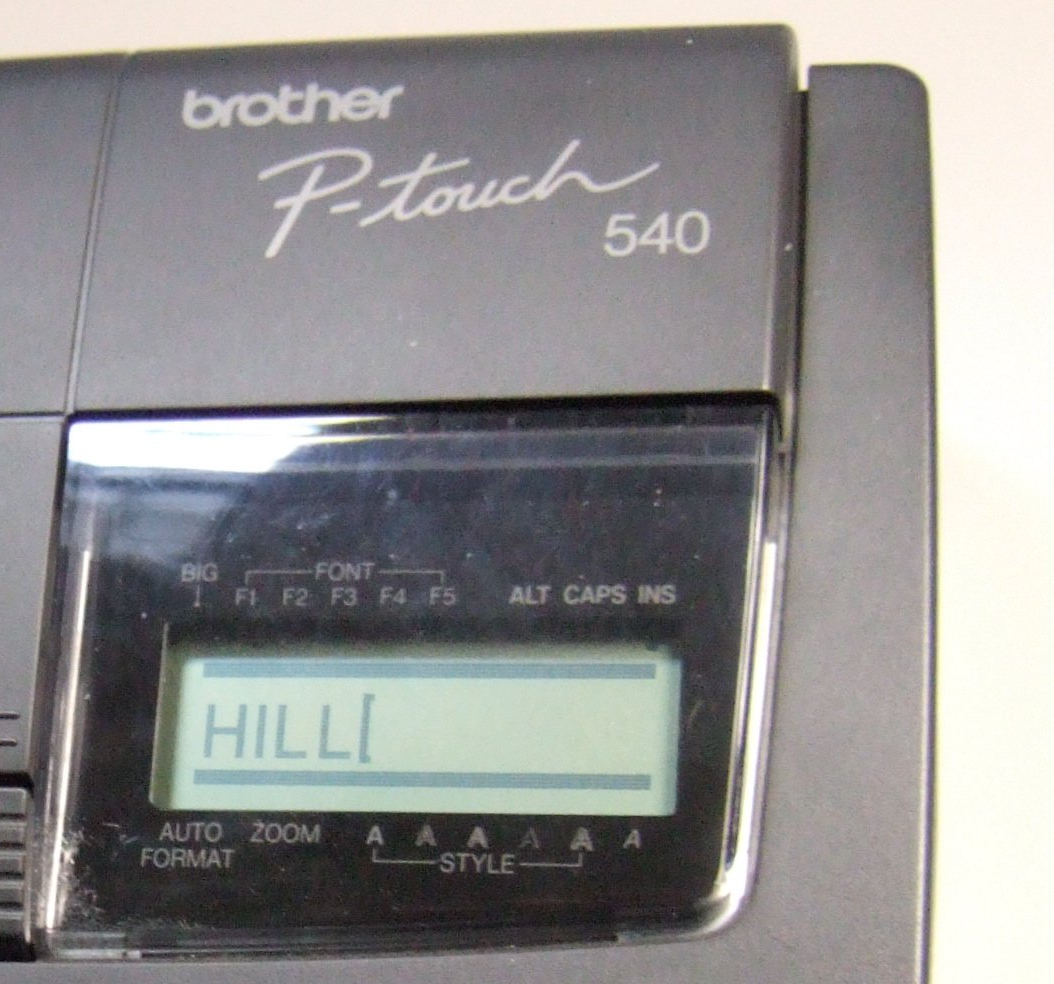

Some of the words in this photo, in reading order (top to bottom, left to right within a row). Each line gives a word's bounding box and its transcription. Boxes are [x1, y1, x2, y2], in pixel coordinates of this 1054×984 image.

[182, 83, 404, 129] brother
[258, 140, 659, 258] P-touch
[604, 212, 710, 257] 540
[181, 563, 218, 582] BIG
[315, 562, 375, 581] FONT
[236, 588, 256, 605] F1
[282, 588, 308, 606] F2
[331, 588, 357, 606] F3
[380, 587, 406, 605] F4
[429, 587, 456, 605] F5
[509, 585, 550, 604] ALT
[563, 584, 626, 605] CAPS
[638, 584, 676, 604] INS
[159, 823, 223, 842] AUTO
[250, 823, 320, 844] ZOOM
[366, 826, 384, 846] A
[140, 848, 235, 868] FORMAT
[440, 853, 515, 874] STYLE
